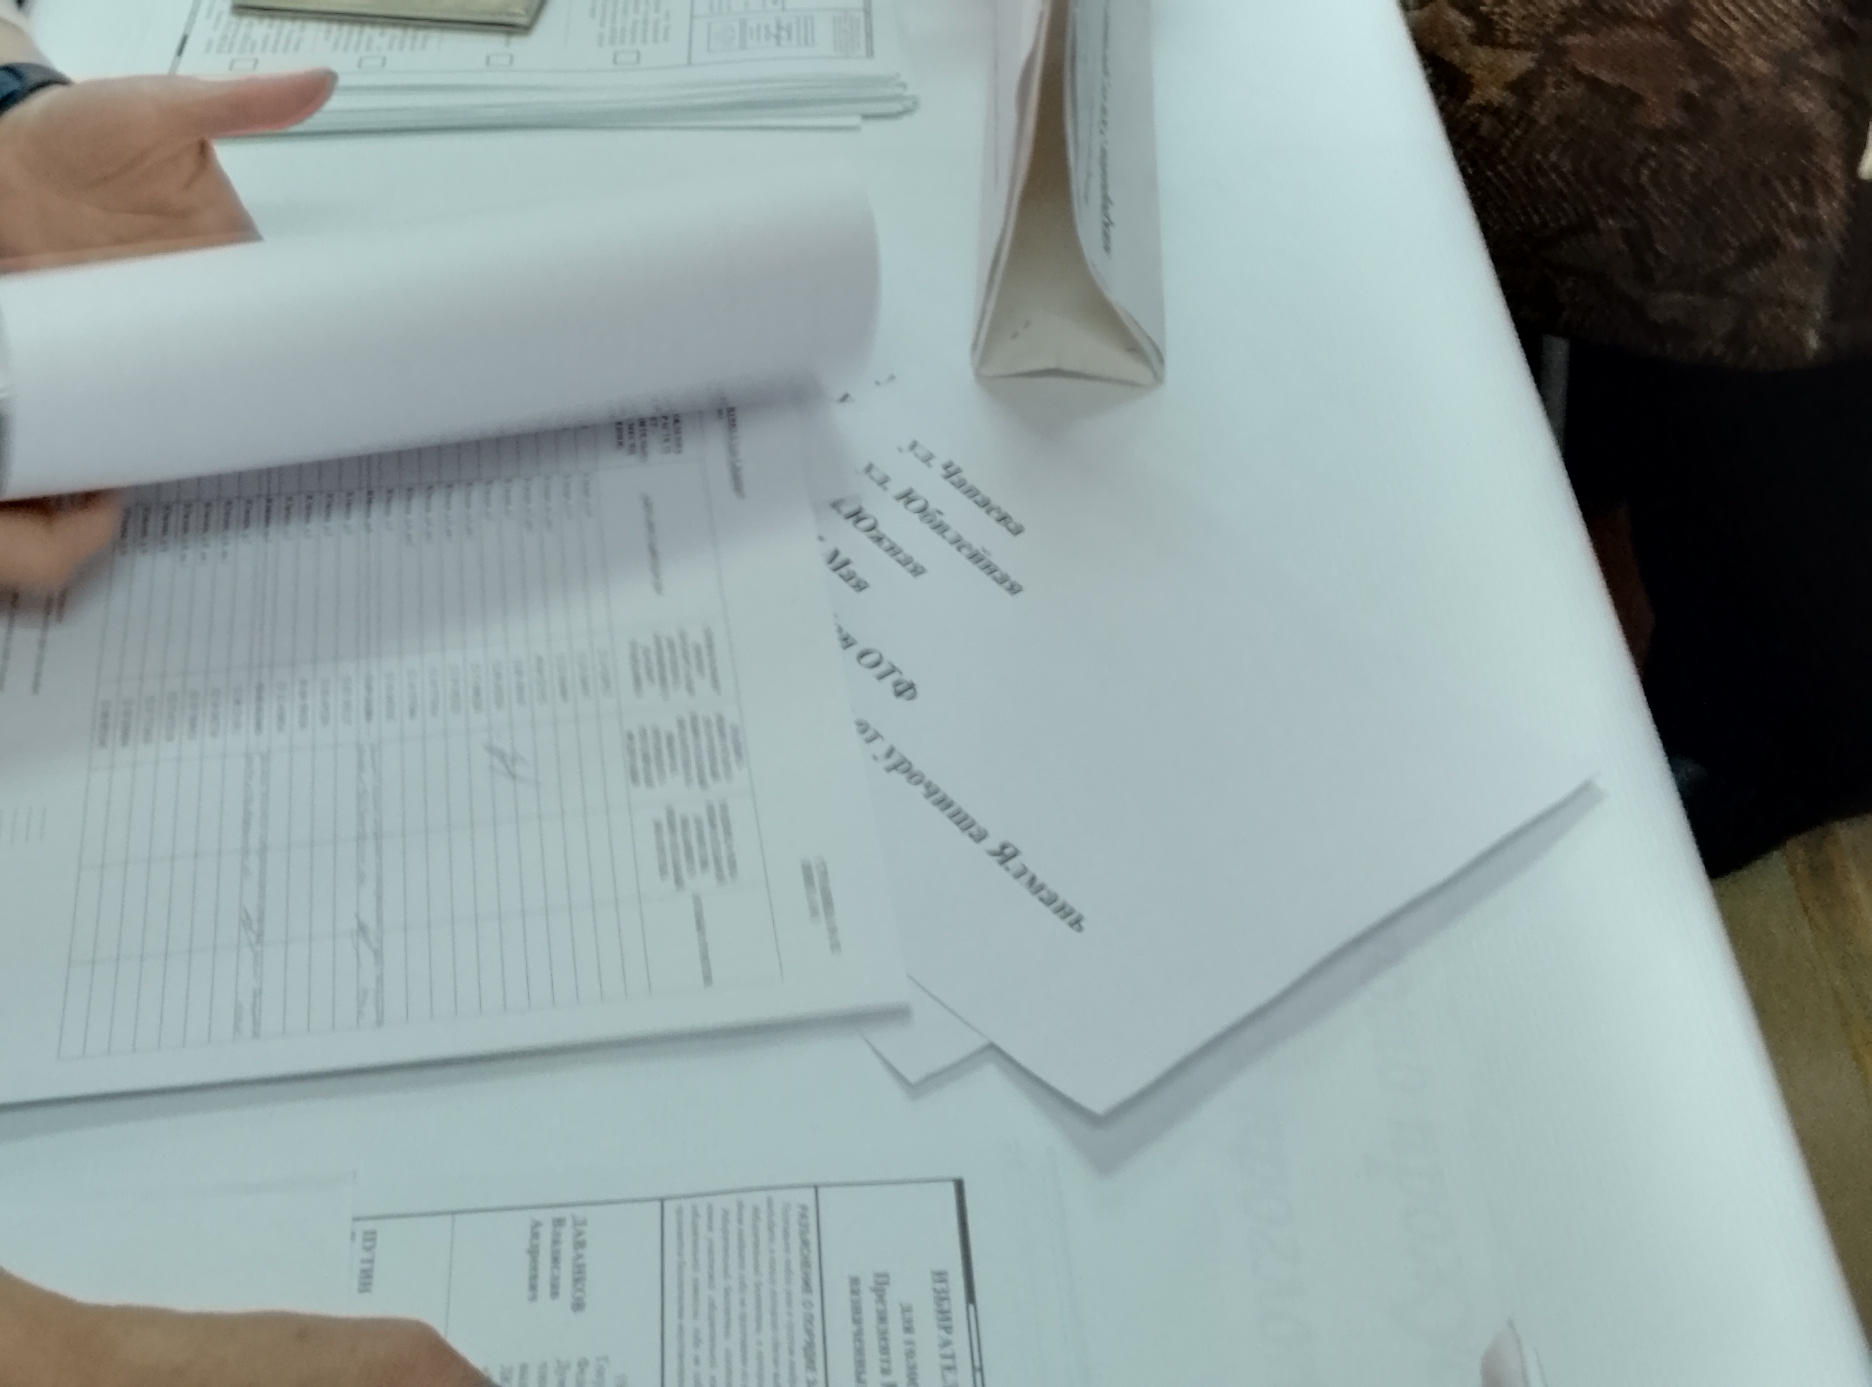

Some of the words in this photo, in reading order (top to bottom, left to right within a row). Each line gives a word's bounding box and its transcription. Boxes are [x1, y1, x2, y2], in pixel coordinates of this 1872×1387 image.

[856, 461, 891, 492] ул.
[893, 487, 1024, 597] Юбилейная
[897, 439, 935, 469] ул.
[941, 459, 1025, 538] Чапаева
[824, 546, 870, 594] Мая
[855, 647, 918, 702] ОТФ
[985, 840, 1086, 934] Ялмань
[357, 1229, 378, 1295] ПУТИН
[570, 1214, 588, 1314] ДАВАНКОВ
[870, 1270, 893, 1377] Президента
